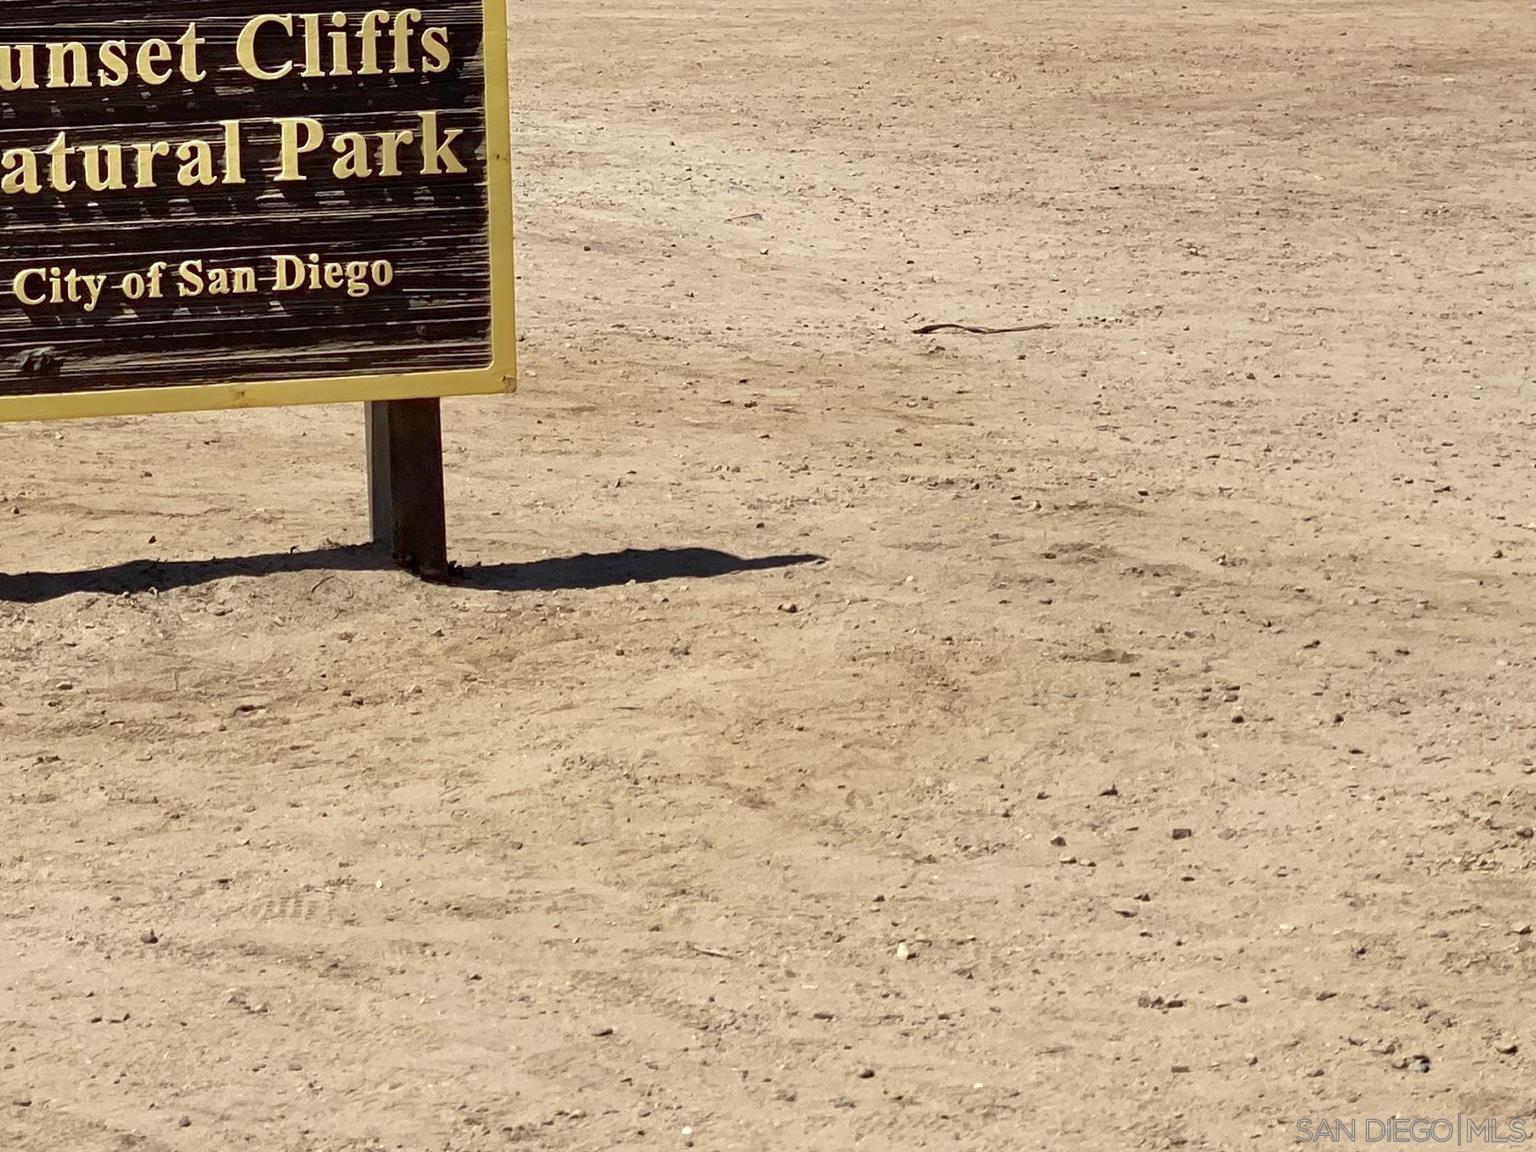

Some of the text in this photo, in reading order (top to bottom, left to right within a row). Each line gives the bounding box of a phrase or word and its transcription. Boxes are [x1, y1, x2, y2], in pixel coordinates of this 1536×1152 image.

[236, 8, 452, 80] Cliffs
[273, 111, 467, 182] Park
[12, 253, 394, 311] City of San Diego
